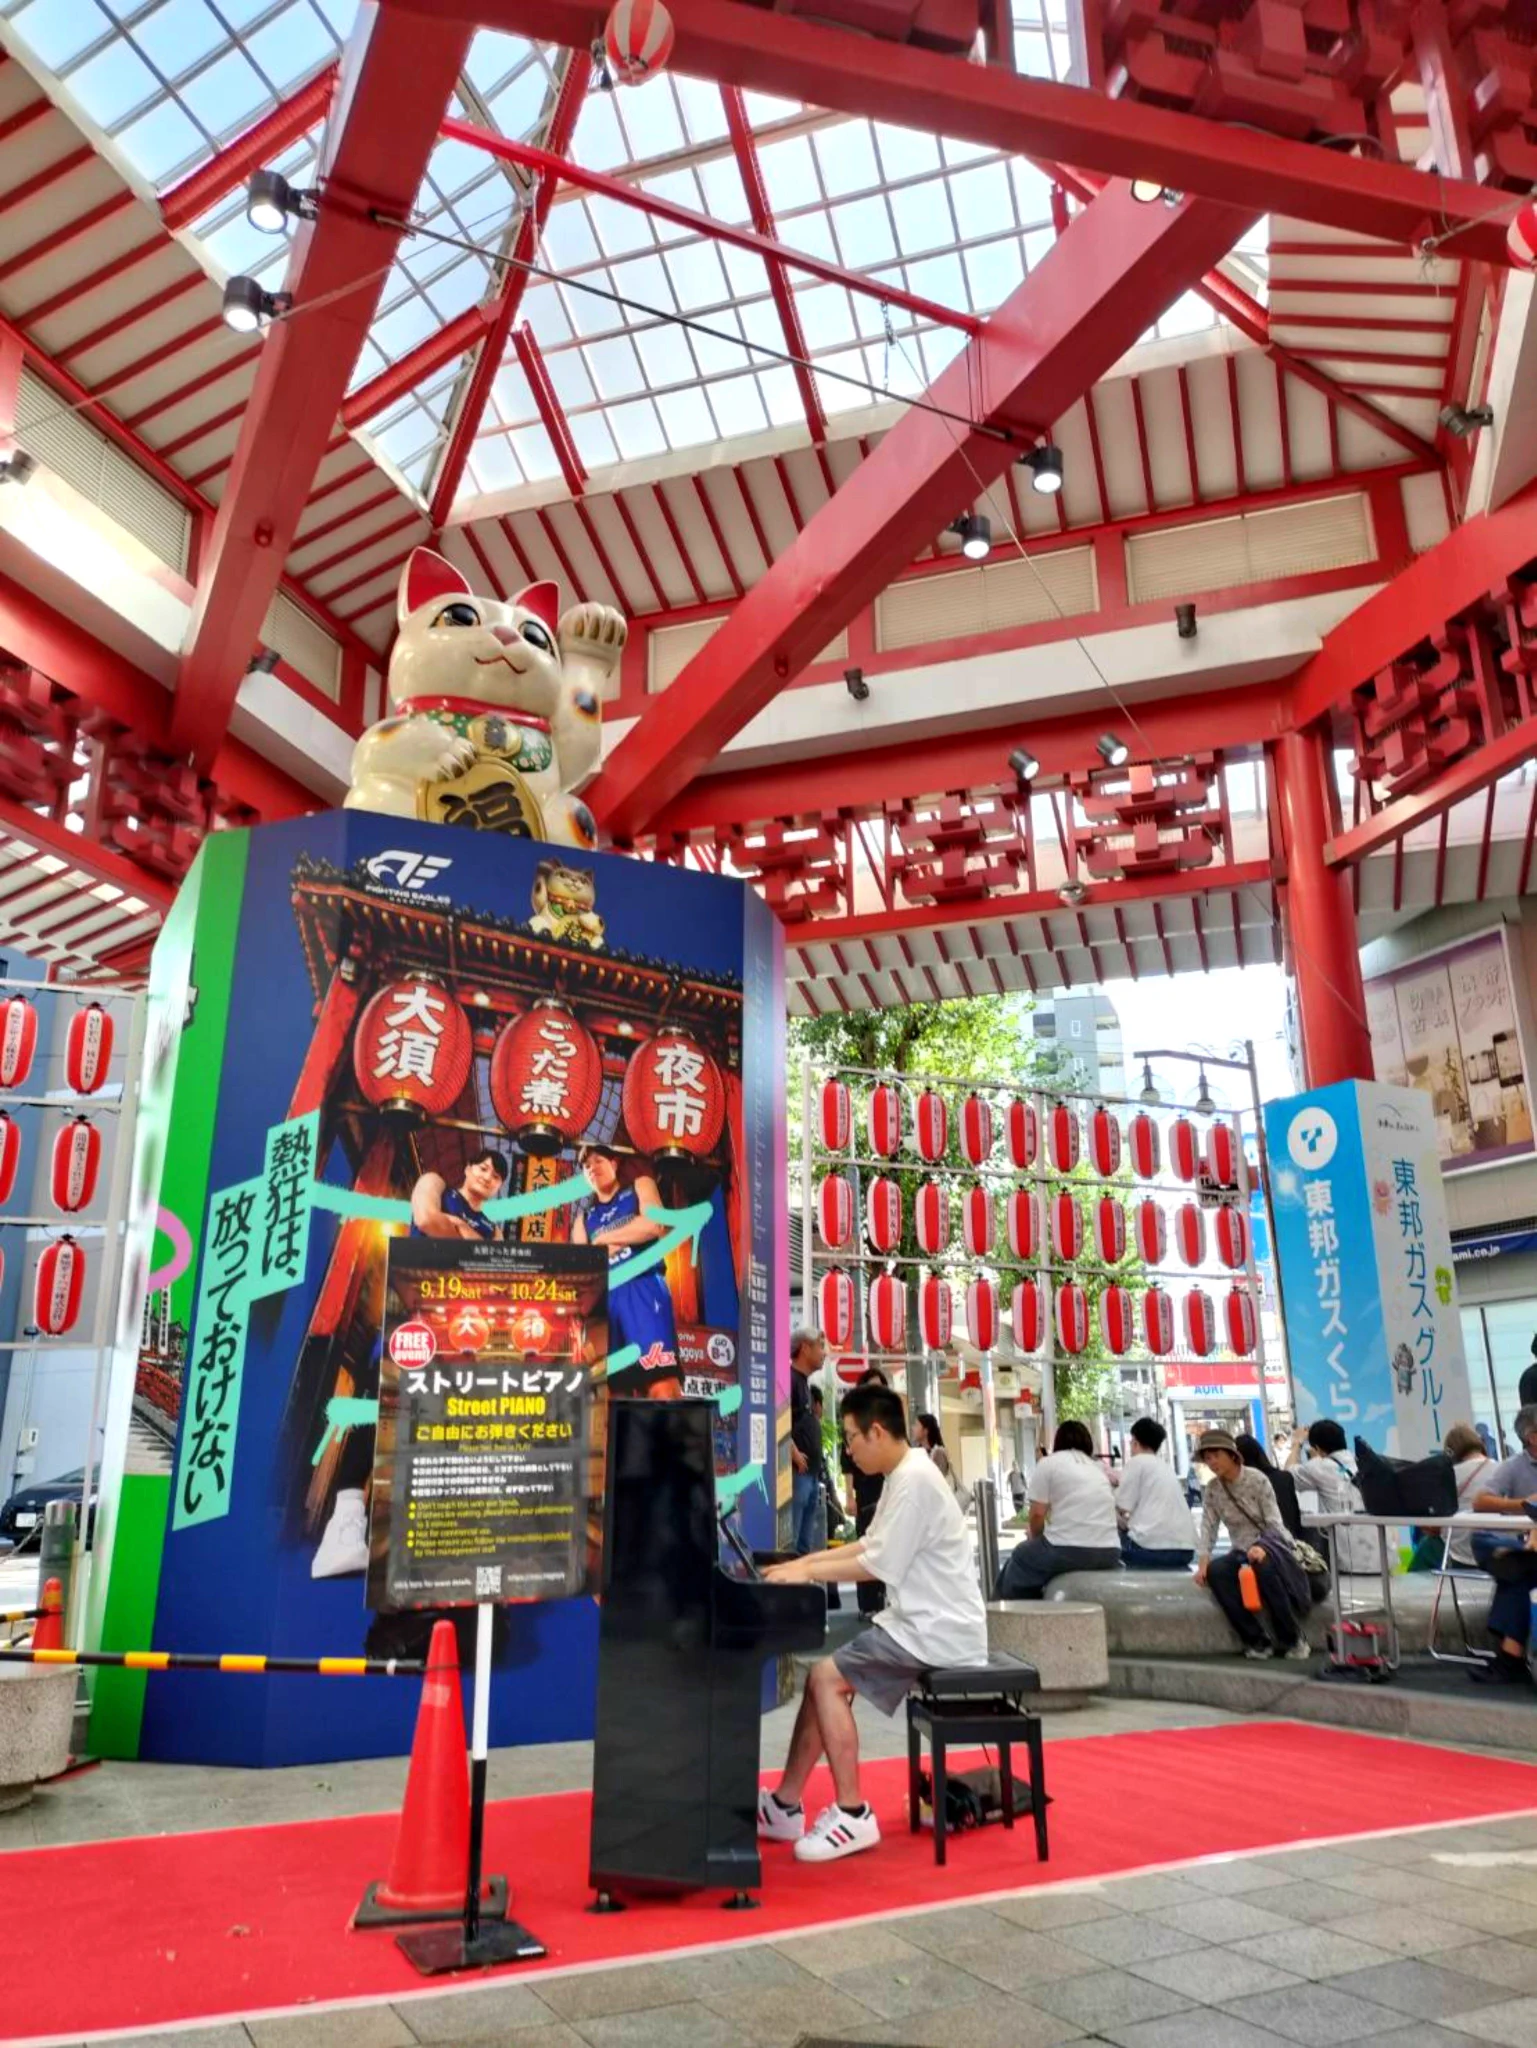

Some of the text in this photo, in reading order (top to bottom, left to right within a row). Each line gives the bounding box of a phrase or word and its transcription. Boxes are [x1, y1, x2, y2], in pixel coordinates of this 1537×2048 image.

[373, 986, 445, 1087] 大須
[519, 1019, 578, 1120] ごった煮
[654, 1043, 708, 1138] 夜市
[184, 1190, 256, 1516] 放っておけない
[395, 1332, 429, 1349] FREE
[1392, 1158, 1445, 1455] 東邦ガスグルー
[407, 1370, 583, 1395] ストリートピアノ
[447, 1396, 546, 1417] Street PIANO
